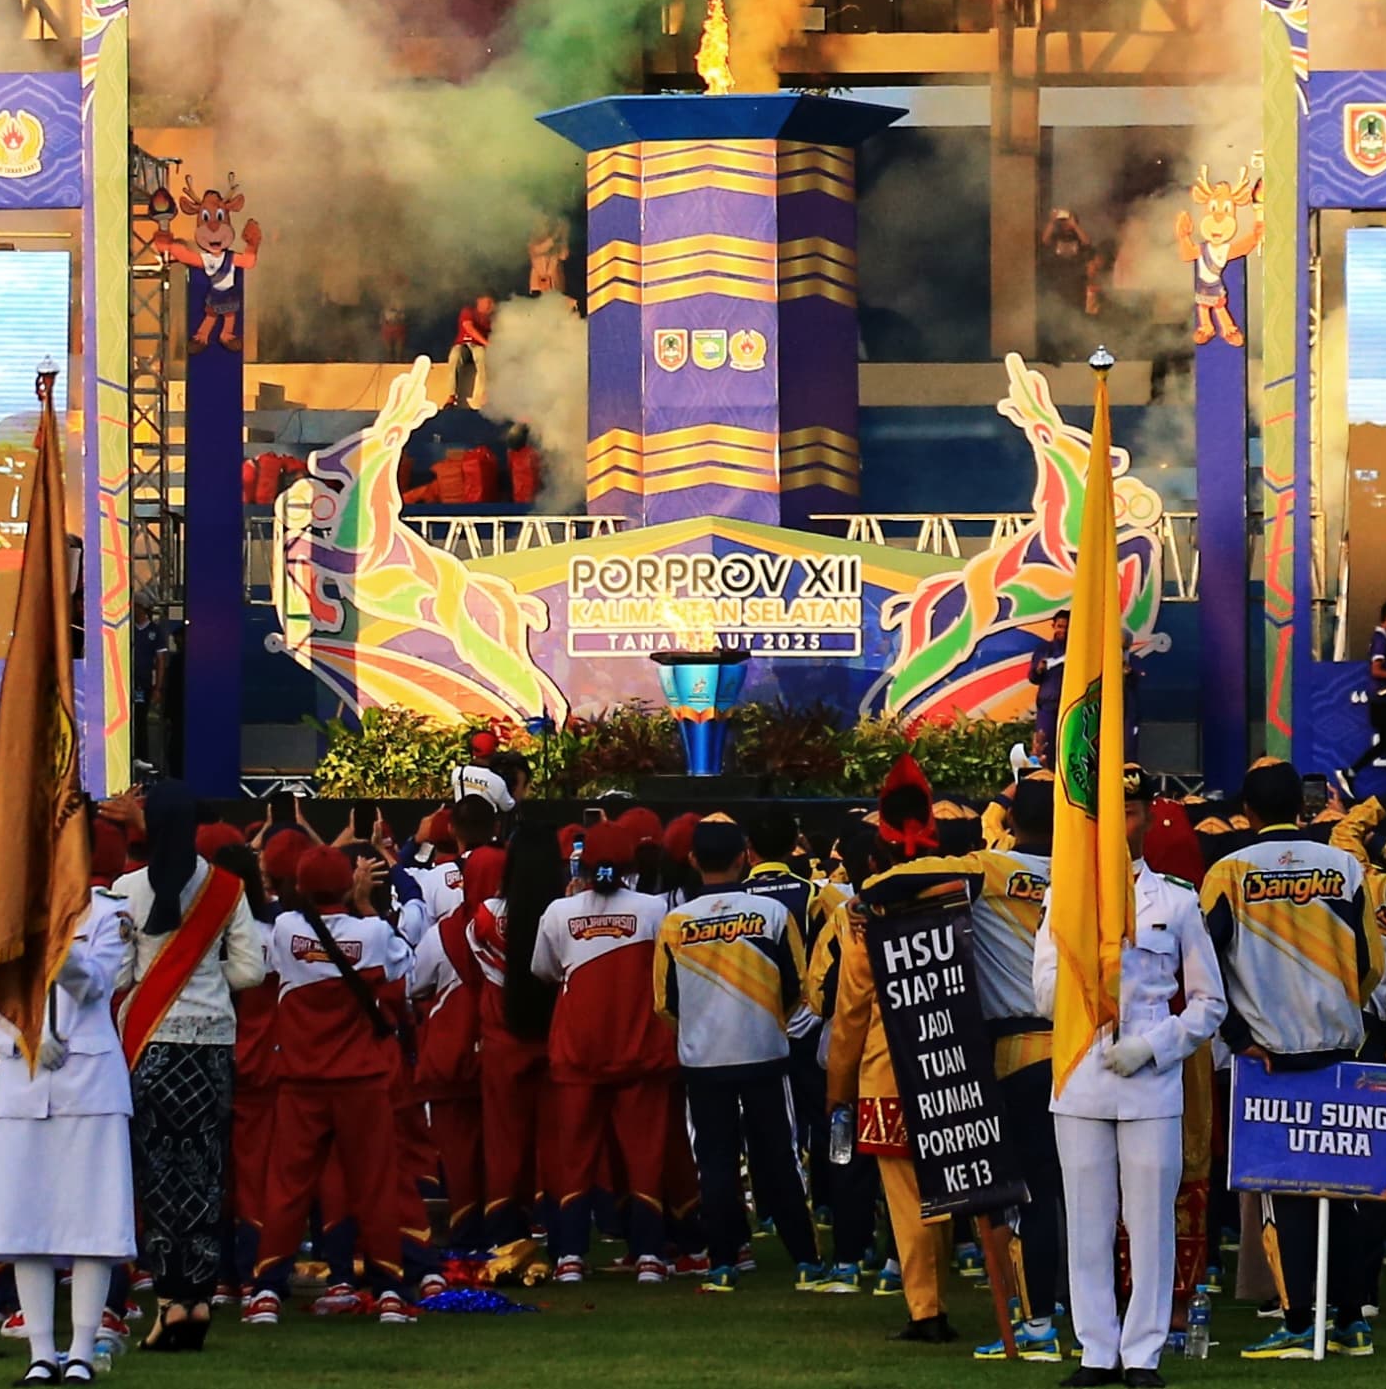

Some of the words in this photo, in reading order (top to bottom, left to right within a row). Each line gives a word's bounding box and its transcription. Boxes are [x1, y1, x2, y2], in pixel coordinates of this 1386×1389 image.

[571, 556, 790, 596] PORPROV
[800, 556, 861, 597] XII
[744, 598, 860, 626] SELATAN
[763, 634, 820, 649] 2025
[883, 925, 955, 973] HSU
[918, 1009, 954, 1042] JADI
[917, 1045, 966, 1080] TUAN
[917, 1081, 983, 1120] RUMAH
[1244, 1097, 1312, 1125] HULU
[917, 1116, 1001, 1159] PORPROV
[1289, 1128, 1371, 1156] UTARA
[943, 1164, 970, 1193] KE
[971, 1160, 992, 1187] 13
